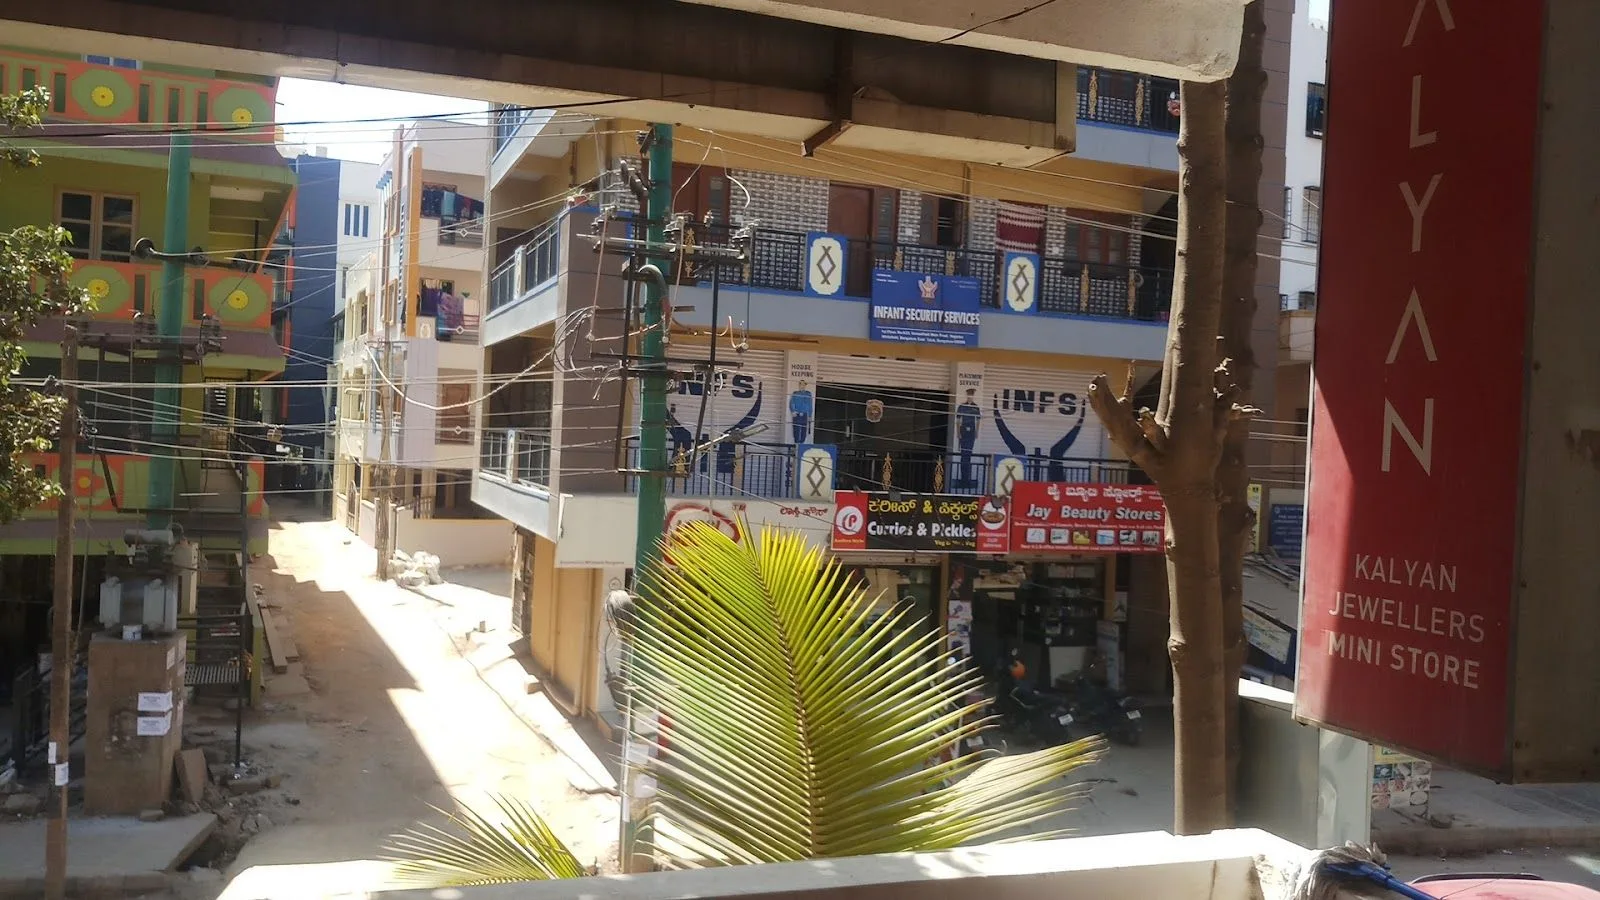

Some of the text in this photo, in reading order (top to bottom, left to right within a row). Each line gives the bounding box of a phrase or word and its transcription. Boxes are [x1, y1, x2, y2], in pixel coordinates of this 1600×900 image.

[874, 305, 980, 325] INFANT SECURITY SERVICES
[1002, 388, 1077, 415] INFS
[922, 499, 933, 514] &
[1026, 503, 1161, 522] Jay Beauty Stores
[867, 521, 977, 538] Curries & Pickles
[1355, 553, 1457, 593] KALYAN
[1328, 591, 1485, 643] JEWELLERS
[1327, 630, 1381, 666] MINI
[1390, 644, 1481, 689] STORE
